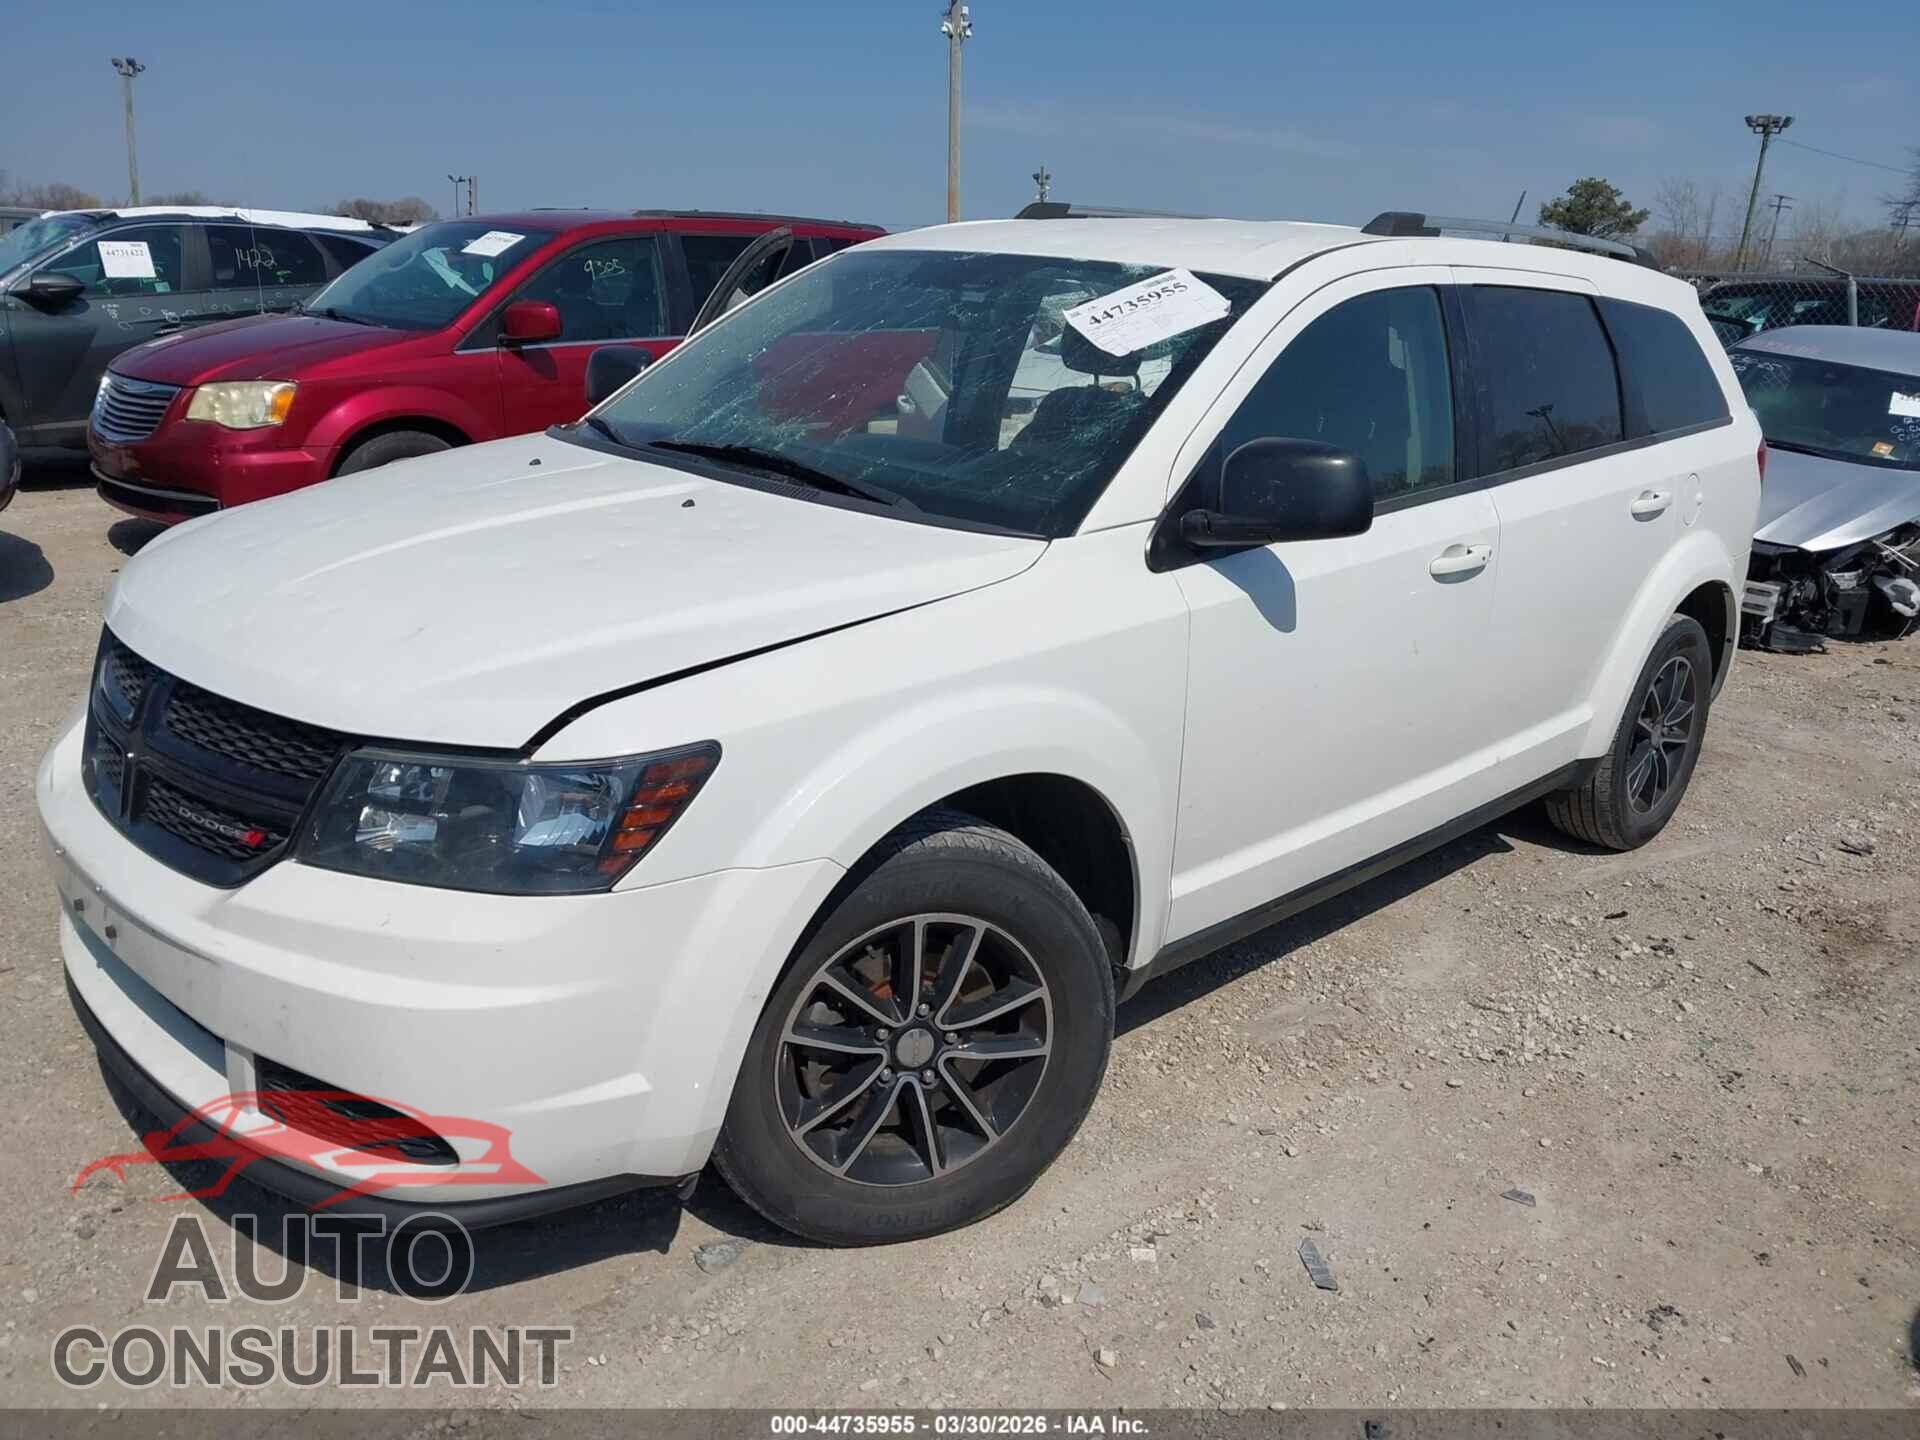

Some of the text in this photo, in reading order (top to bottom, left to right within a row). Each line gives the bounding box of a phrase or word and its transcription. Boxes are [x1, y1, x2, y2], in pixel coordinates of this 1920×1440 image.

[235, 247, 278, 269] 1422
[583, 258, 625, 279] 9305
[1088, 281, 1189, 325] 44735955
[179, 807, 244, 840] DODGE
